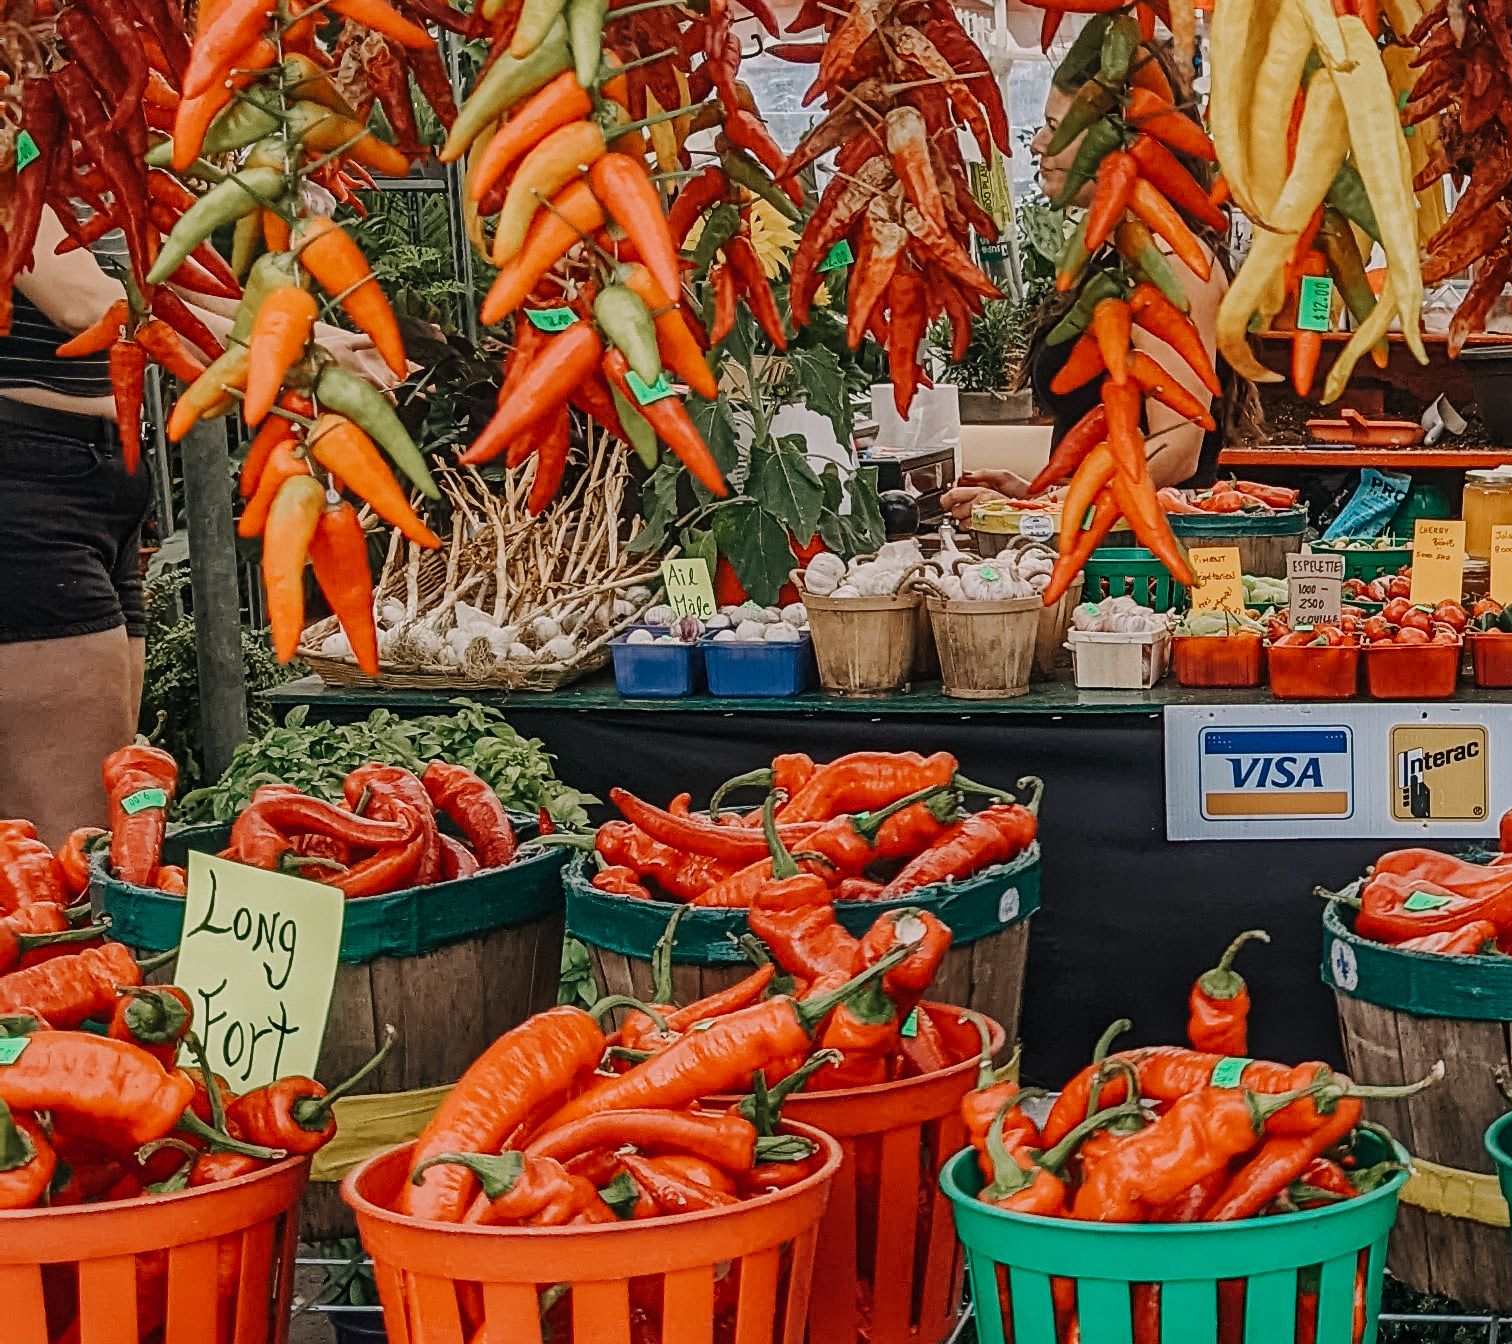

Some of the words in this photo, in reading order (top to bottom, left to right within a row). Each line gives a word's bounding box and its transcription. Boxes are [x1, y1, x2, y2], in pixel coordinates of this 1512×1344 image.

[1312, 281, 1330, 321] $12.00
[668, 563, 699, 586] Ail
[1292, 560, 1343, 573] ESPELETTE
[1298, 583, 1317, 595] 1000
[1298, 598, 1326, 610] 2500
[1226, 756, 1324, 788] VISA
[1398, 741, 1480, 790] Interac
[197, 978, 300, 1082] Fort
